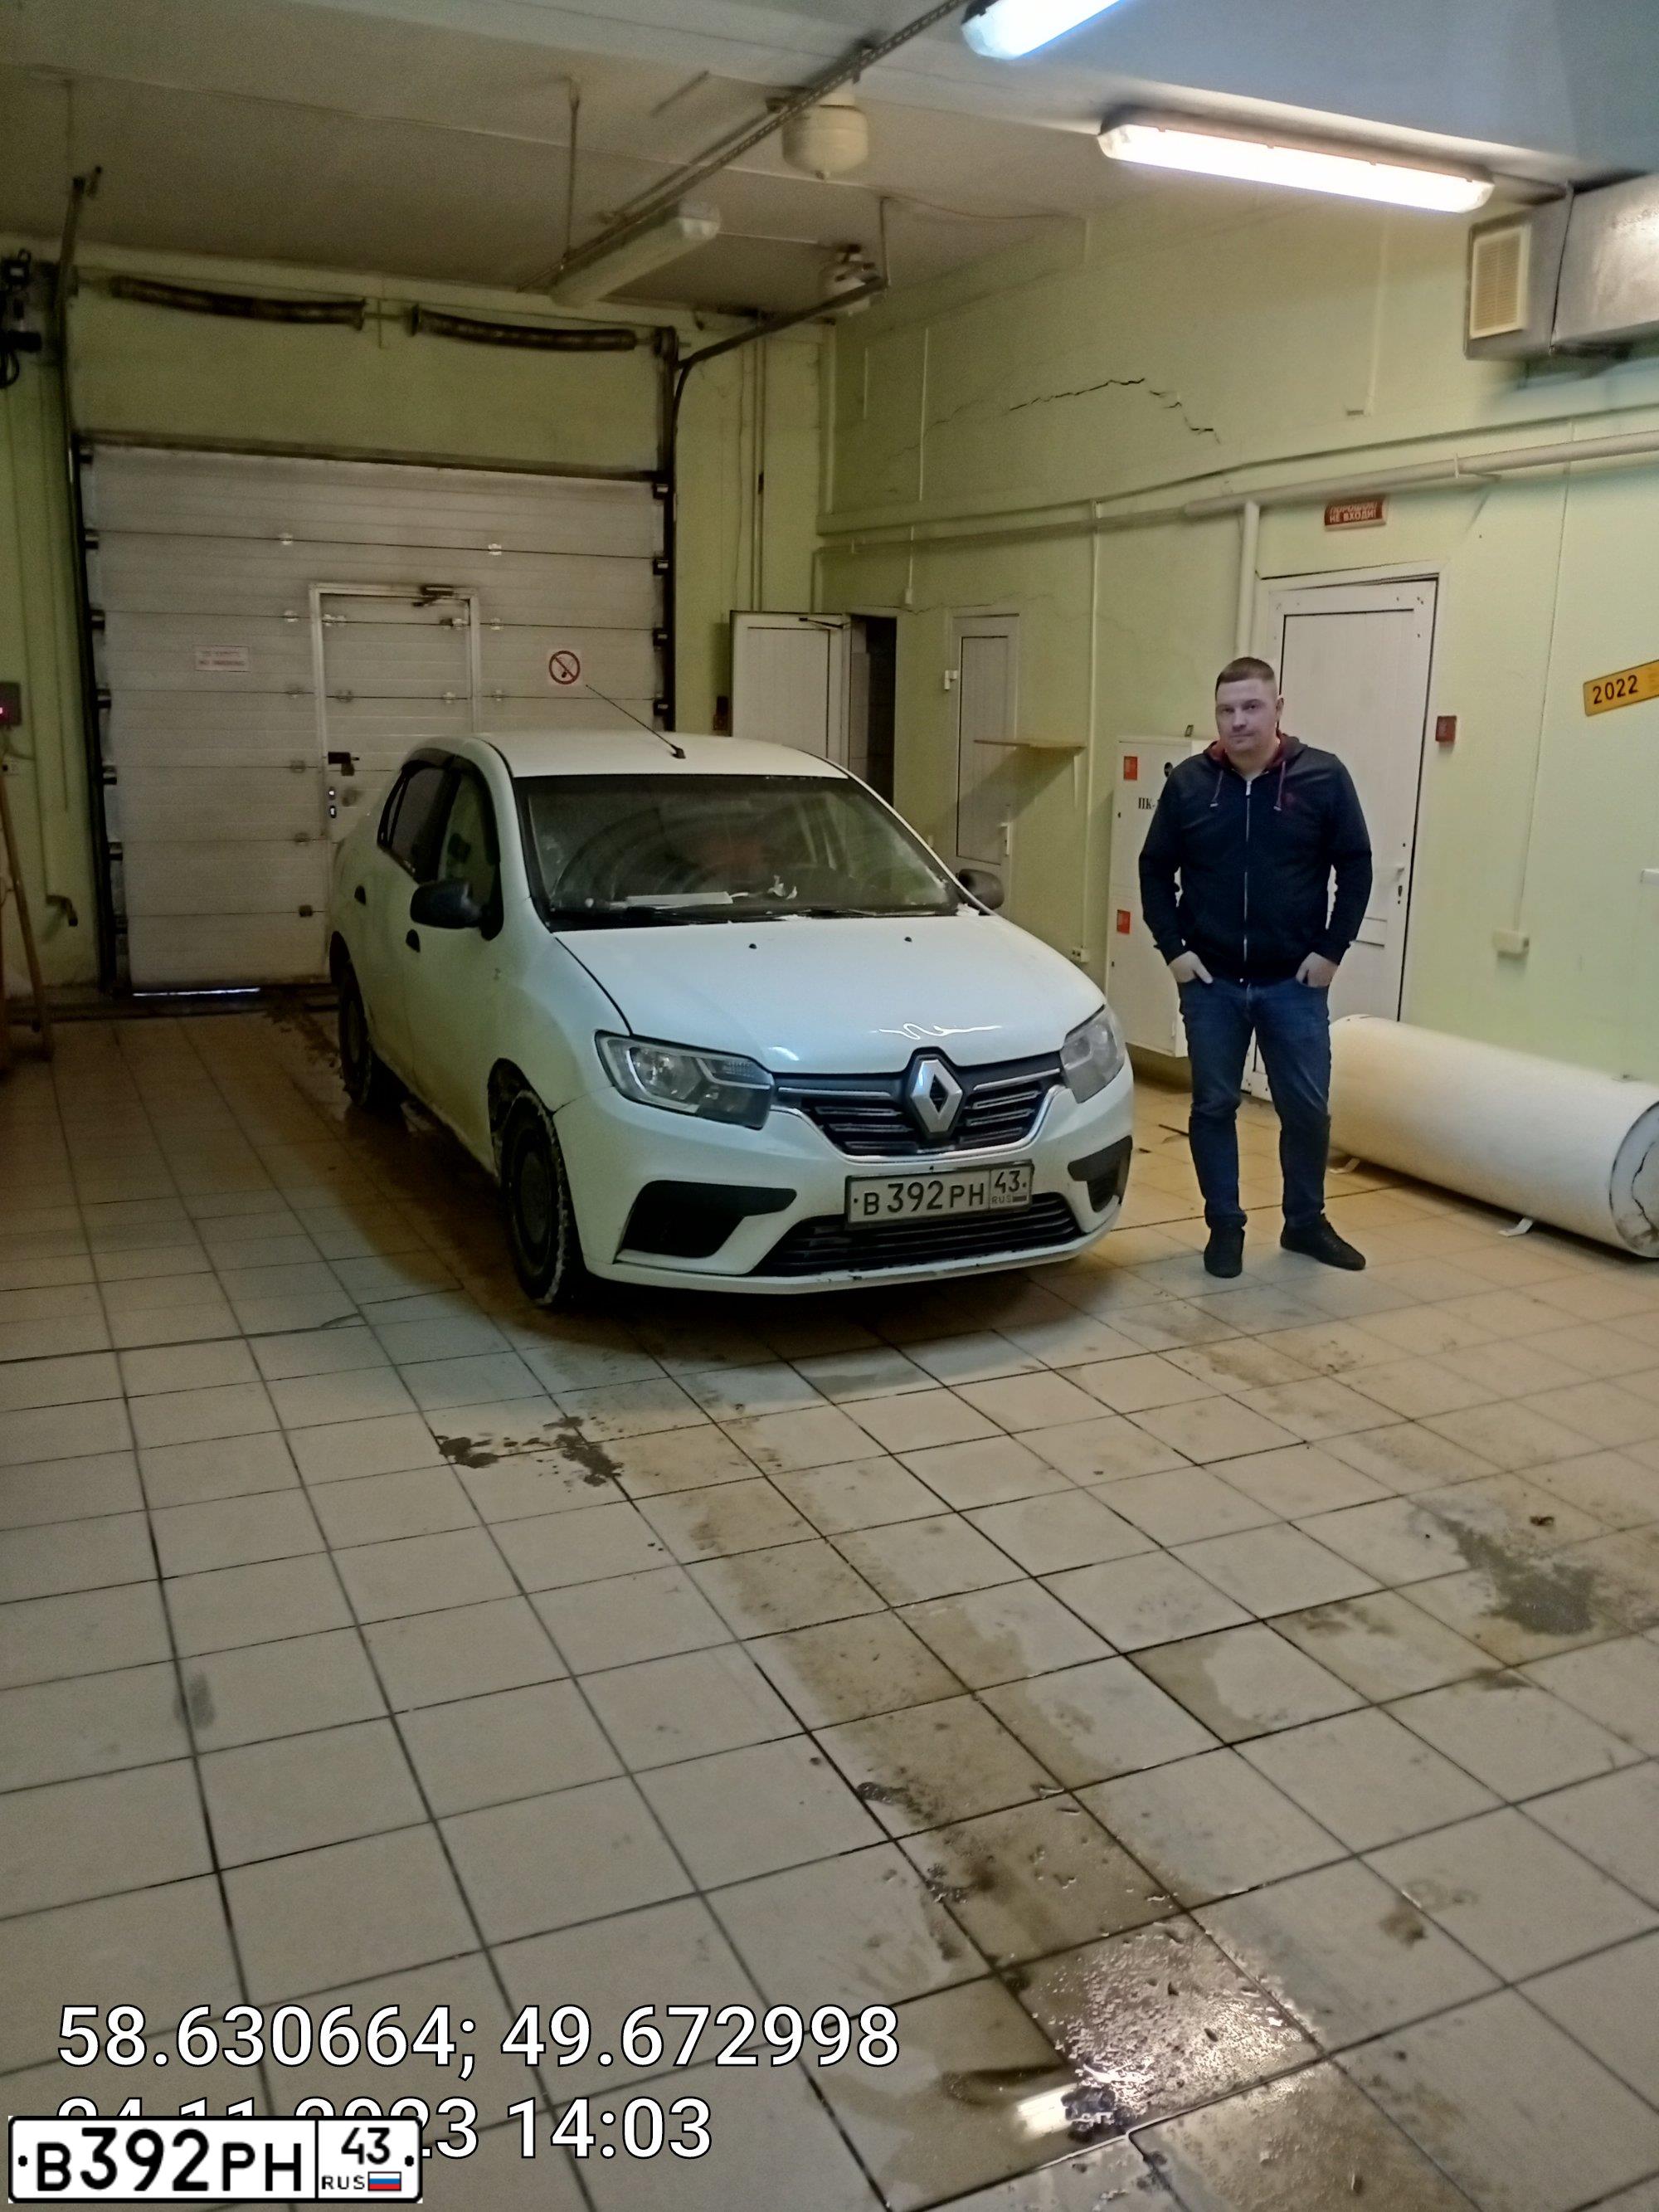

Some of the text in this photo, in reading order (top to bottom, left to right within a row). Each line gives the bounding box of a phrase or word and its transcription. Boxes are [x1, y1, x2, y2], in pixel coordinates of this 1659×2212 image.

[1329, 509, 1377, 524] НЕ ВХОДИ!
[1592, 674, 1639, 705] 2022
[994, 1170, 1021, 1194] 43
[991, 1195, 1012, 1204] RUS
